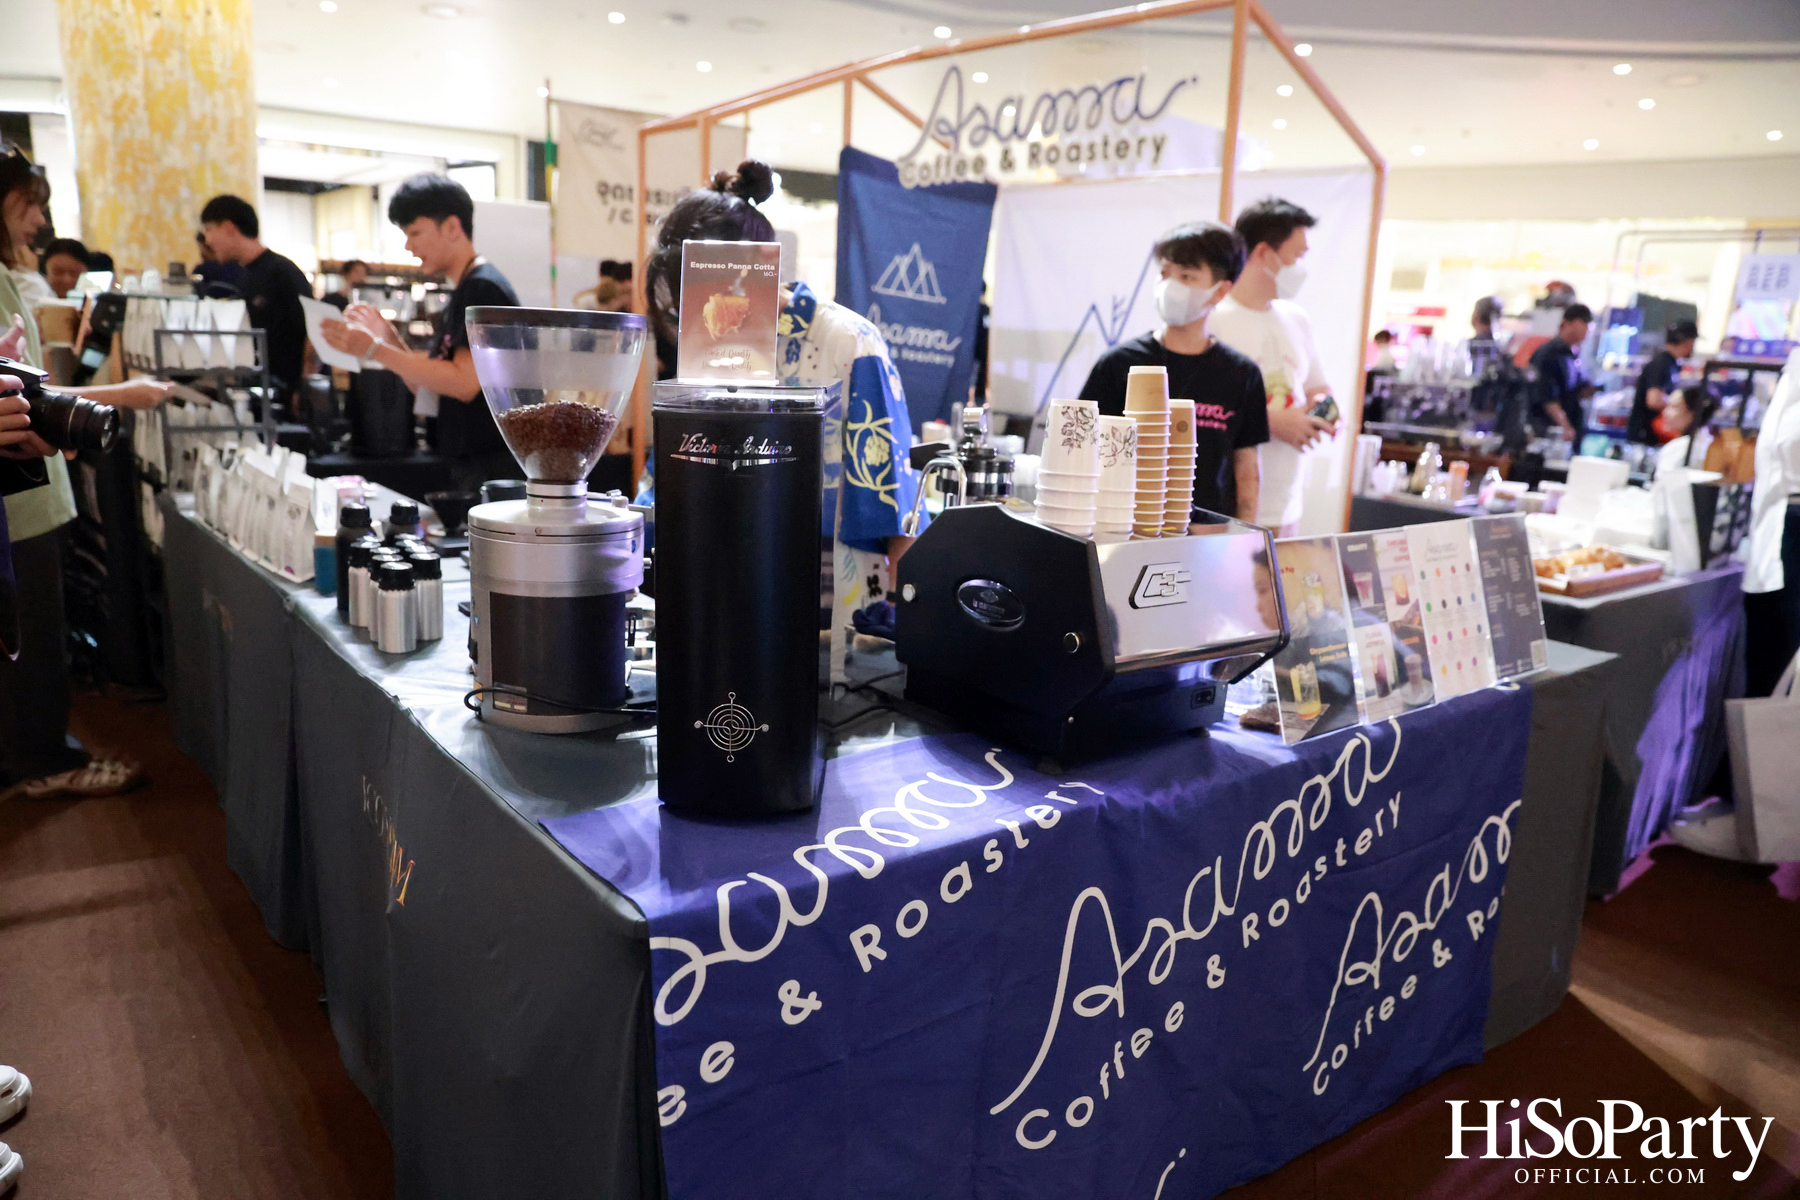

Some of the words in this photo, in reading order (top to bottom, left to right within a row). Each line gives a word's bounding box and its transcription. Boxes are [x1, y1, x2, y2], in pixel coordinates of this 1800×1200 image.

[899, 65, 1197, 162] Asama
[901, 153, 987, 187] Coffee
[1000, 145, 1014, 171] &
[1028, 134, 1167, 169] Roastery
[690, 261, 726, 269] Espresso
[727, 262, 752, 270] Panna
[753, 263, 775, 271] Cotta
[778, 980, 822, 1025] &
[849, 782, 1104, 972] Roastery
[990, 716, 1401, 1114] Asama
[1016, 1001, 1185, 1149] Coffee
[1207, 955, 1226, 989] &
[1242, 792, 1401, 948] Roastery
[1313, 975, 1417, 1095] Coffee
[1432, 939, 1452, 968] &
[1466, 885, 1506, 941] Ro
